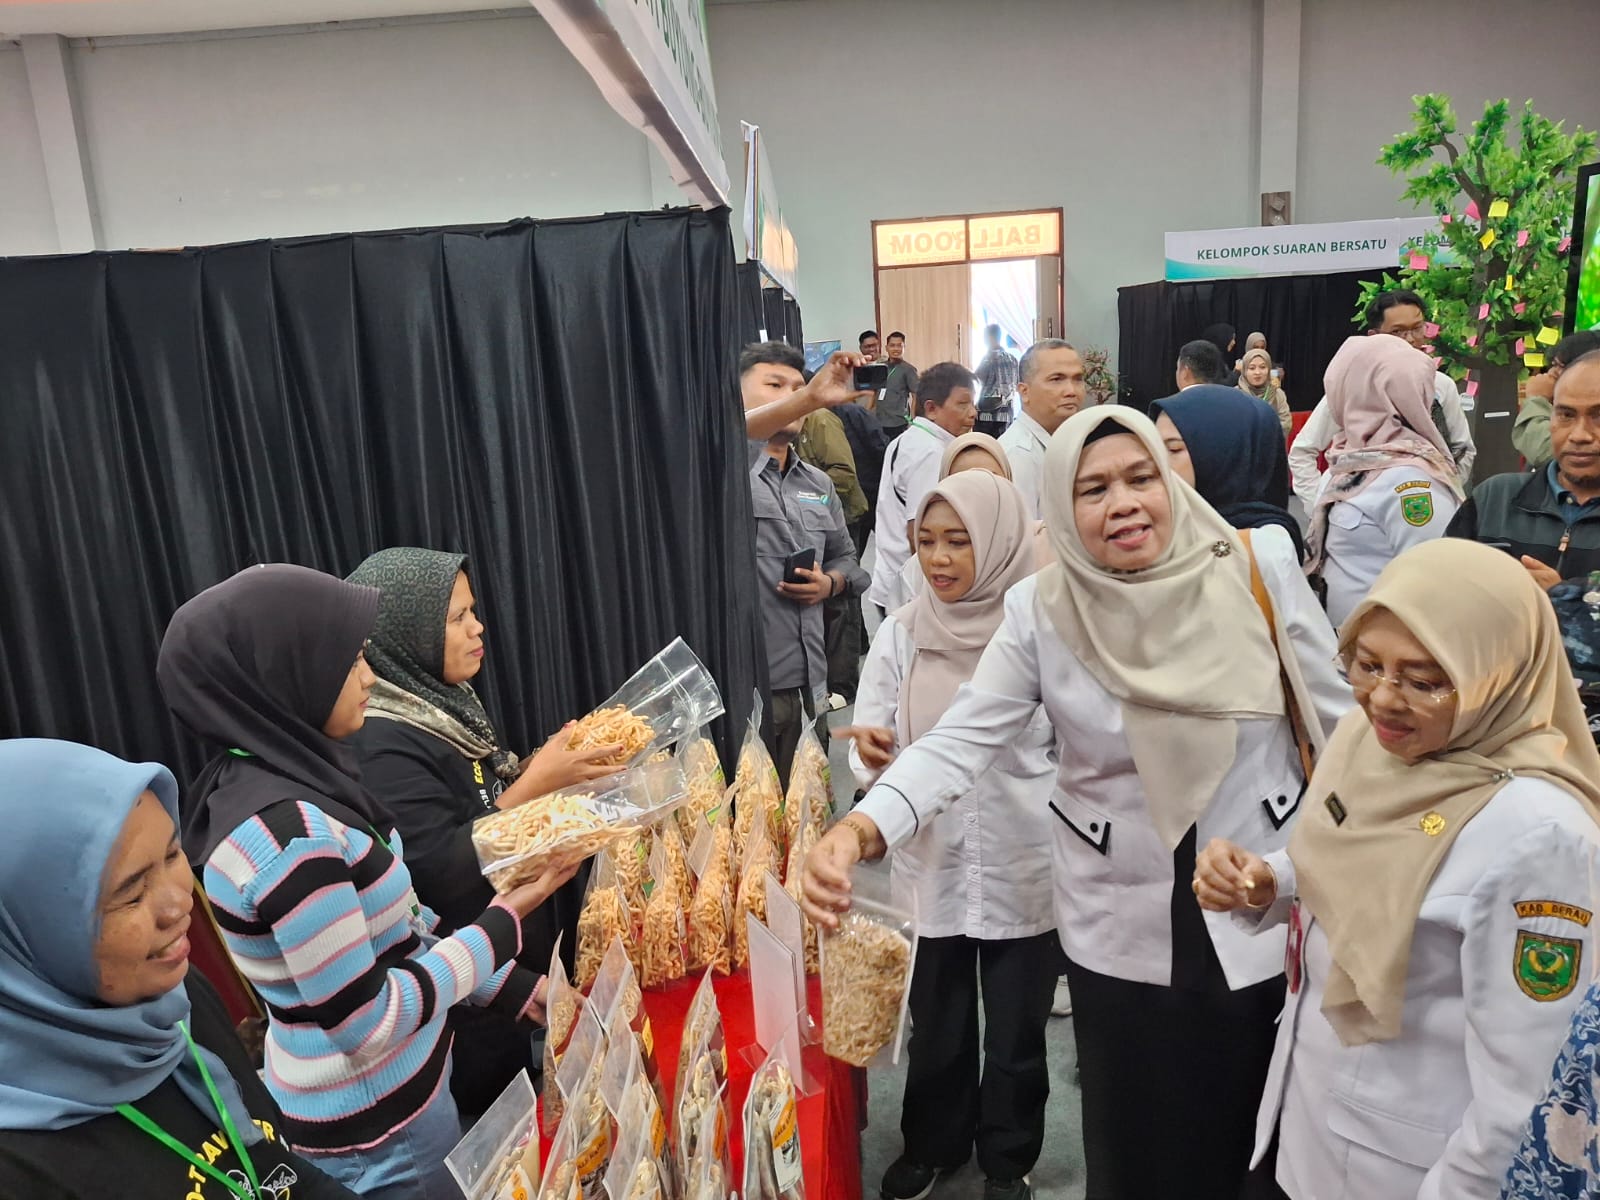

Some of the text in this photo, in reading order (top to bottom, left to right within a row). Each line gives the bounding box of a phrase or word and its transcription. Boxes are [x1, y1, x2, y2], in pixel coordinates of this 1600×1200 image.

[1197, 239, 1387, 260] KELOMPOK SUARAN BERSATU
